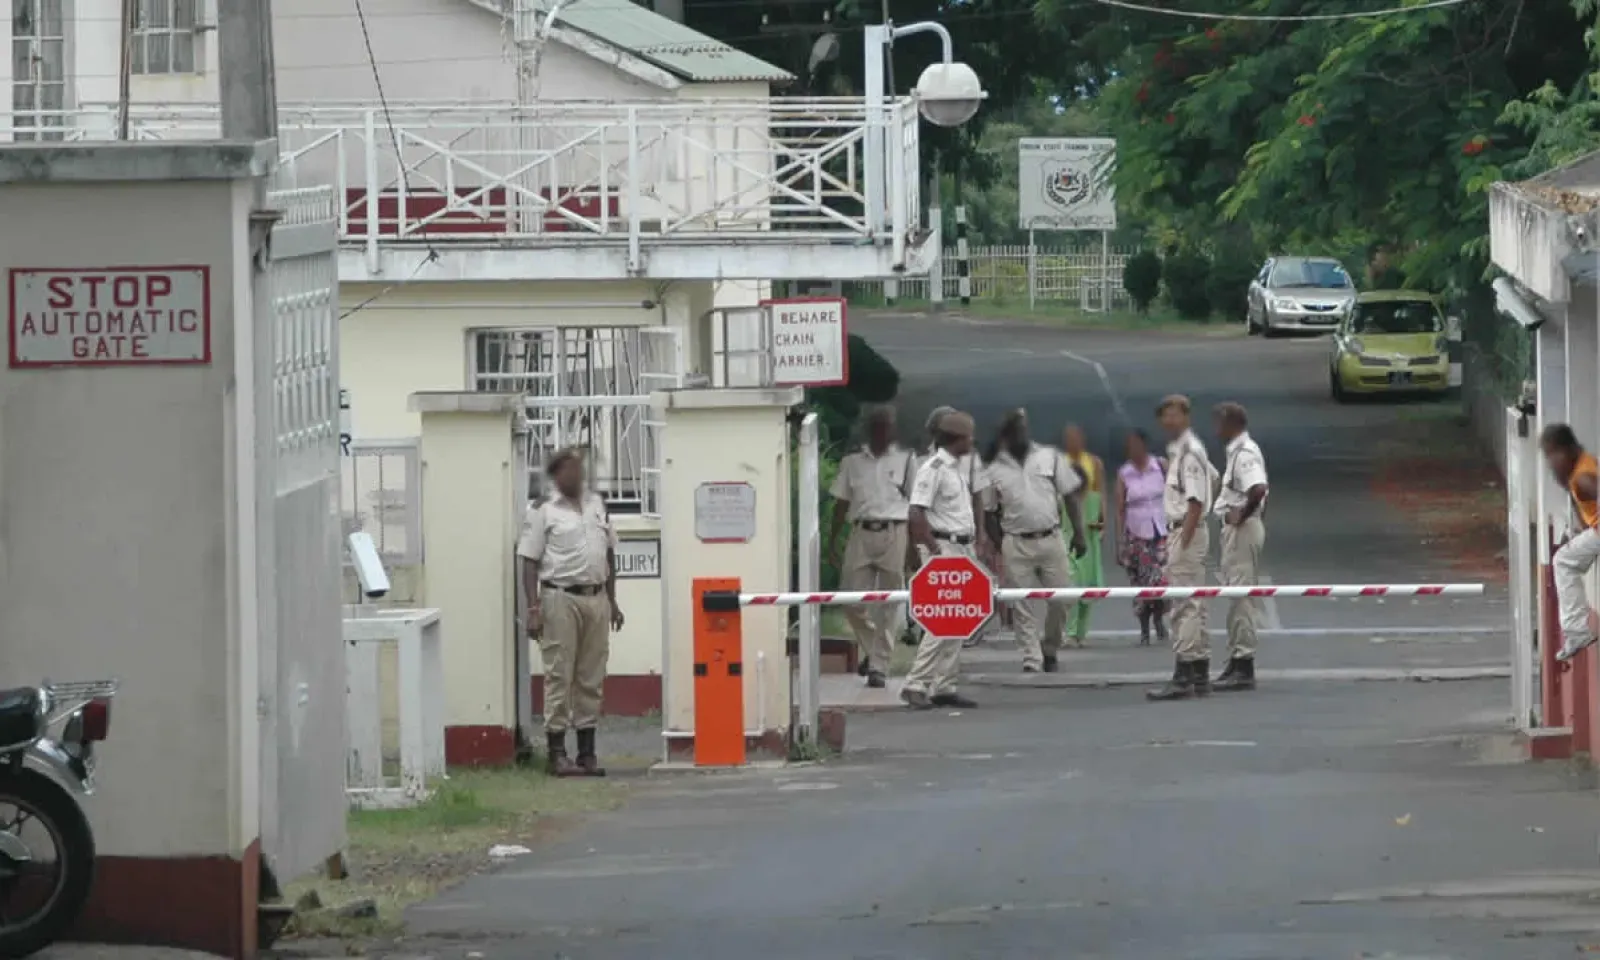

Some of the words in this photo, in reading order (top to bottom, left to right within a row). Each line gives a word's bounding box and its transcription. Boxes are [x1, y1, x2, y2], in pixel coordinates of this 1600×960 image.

[47, 275, 172, 309] STOP
[21, 309, 198, 335] AUTOMATIC
[780, 310, 838, 325] BEWARE
[72, 336, 150, 358] GATE
[775, 333, 815, 346] CHAIN
[927, 570, 973, 585] STOP
[937, 588, 962, 600] FOR
[913, 603, 987, 618] CONTROL
